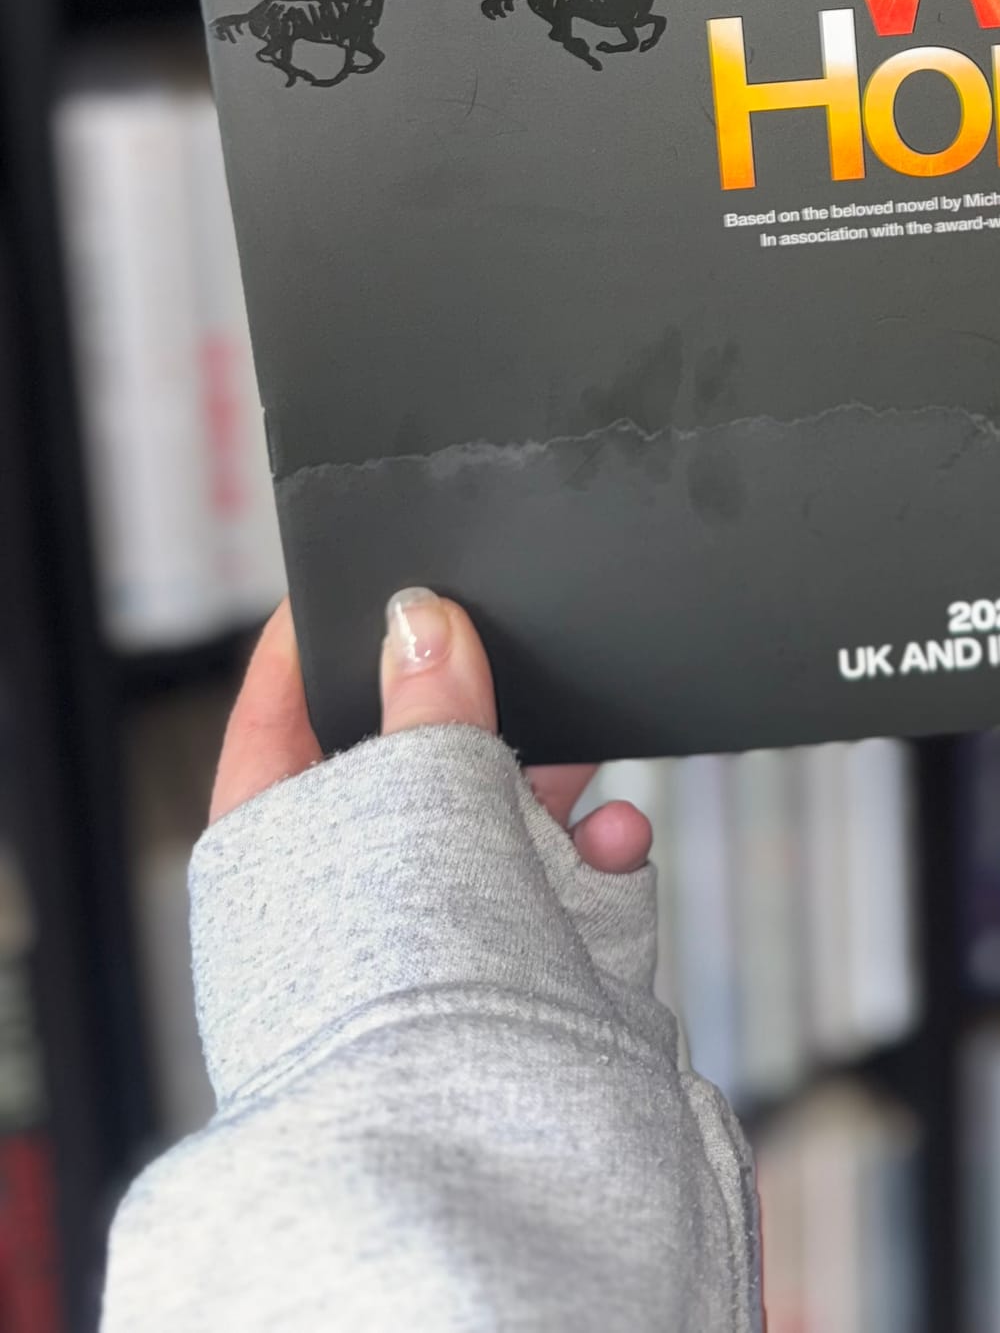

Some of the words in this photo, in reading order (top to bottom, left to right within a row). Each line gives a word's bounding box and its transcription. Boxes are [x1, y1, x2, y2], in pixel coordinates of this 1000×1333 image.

[723, 210, 776, 228] Based
[778, 210, 800, 223] on
[801, 207, 829, 221] the
[830, 201, 894, 218] beloved
[895, 196, 939, 214] novel
[940, 195, 962, 212] by
[760, 233, 777, 247] In
[778, 225, 869, 246] association
[870, 223, 905, 238] with
[906, 220, 933, 235] the
[838, 645, 895, 681] UK
[899, 638, 983, 675] AND
